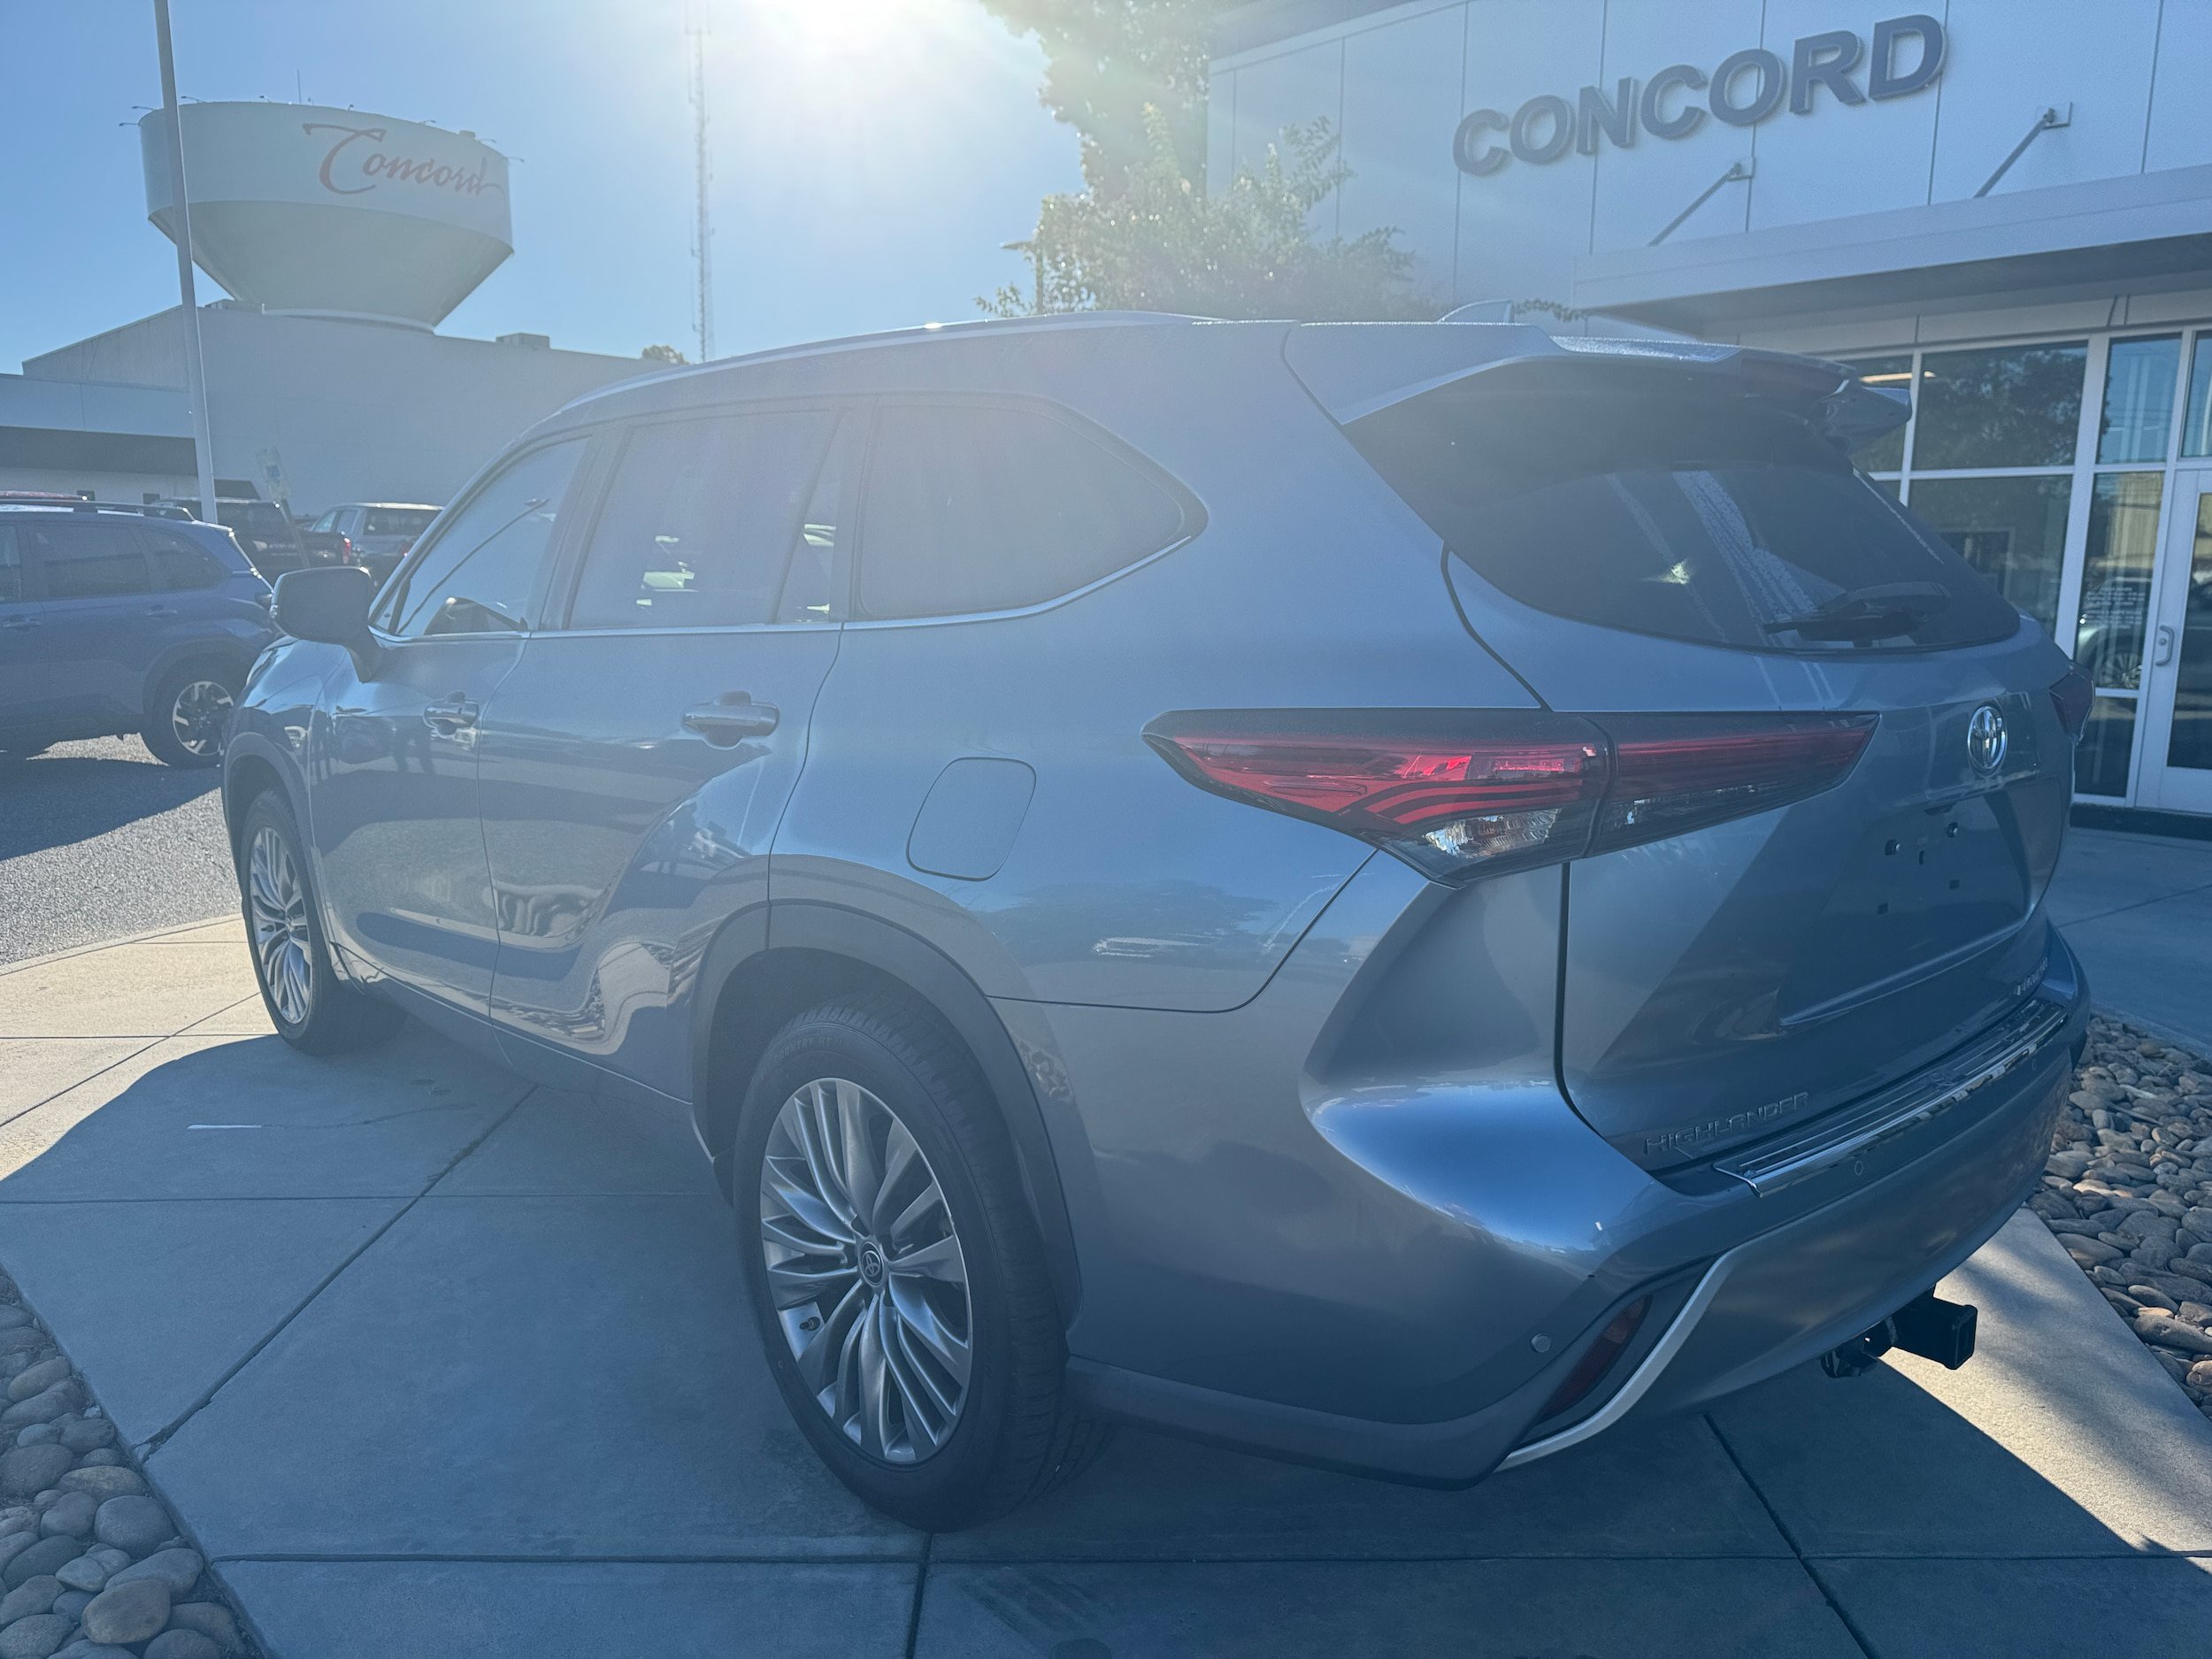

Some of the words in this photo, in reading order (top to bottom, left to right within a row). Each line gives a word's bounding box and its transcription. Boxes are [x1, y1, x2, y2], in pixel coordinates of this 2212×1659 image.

[1452, 14, 1947, 176] CONCORD
[303, 122, 506, 218] Concord
[1643, 1091, 1809, 1155] HIGHLANDER
